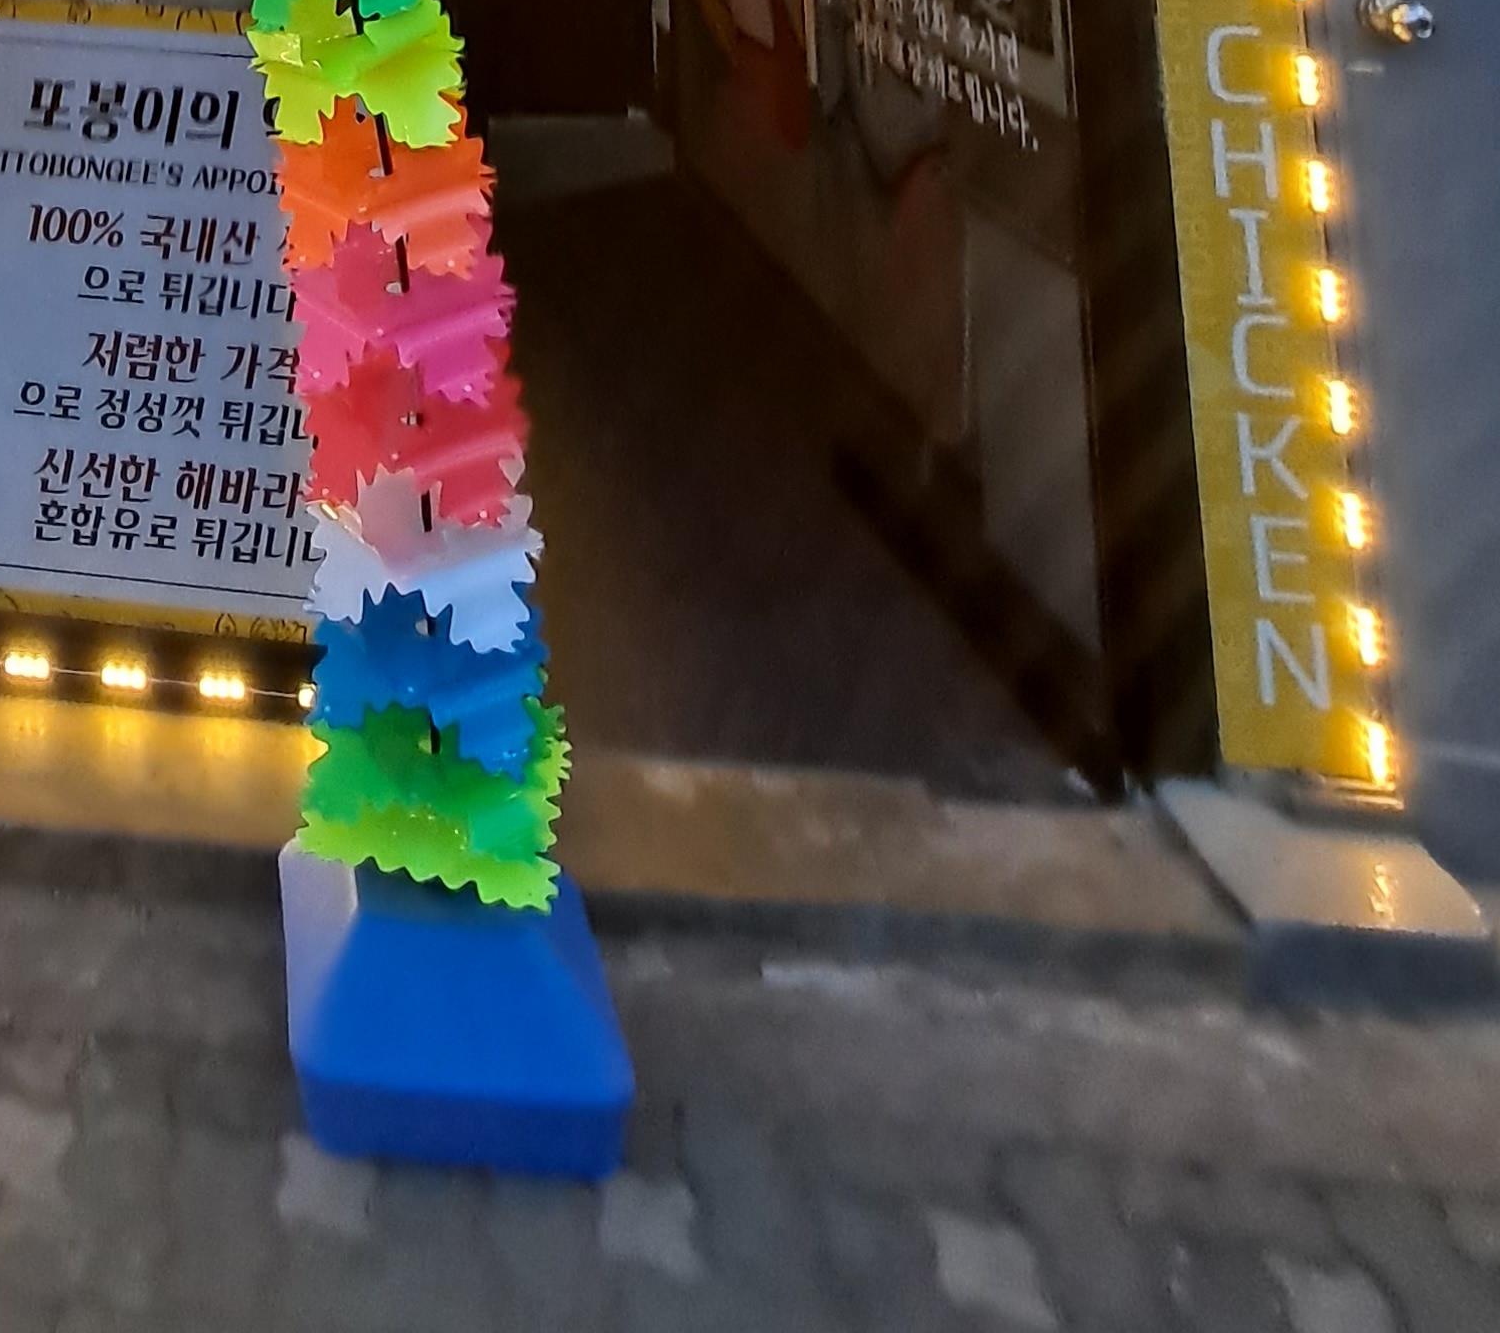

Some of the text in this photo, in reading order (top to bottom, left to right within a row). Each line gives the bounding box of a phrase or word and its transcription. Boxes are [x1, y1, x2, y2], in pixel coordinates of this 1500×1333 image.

[24, 78, 239, 150] 또봉이의
[192, 164, 284, 196] APPOI
[29, 203, 124, 249] 100%
[140, 213, 261, 266] 국내산
[78, 265, 297, 322] 으로 튀깁니다
[82, 330, 207, 386] 저렴한
[1206, 26, 1332, 711] CHICKEN
[14, 380, 320, 450] 으로 정성껏 튀깁니
[34, 447, 304, 519] 신선한 해바라
[35, 499, 177, 553] 혼합유로
